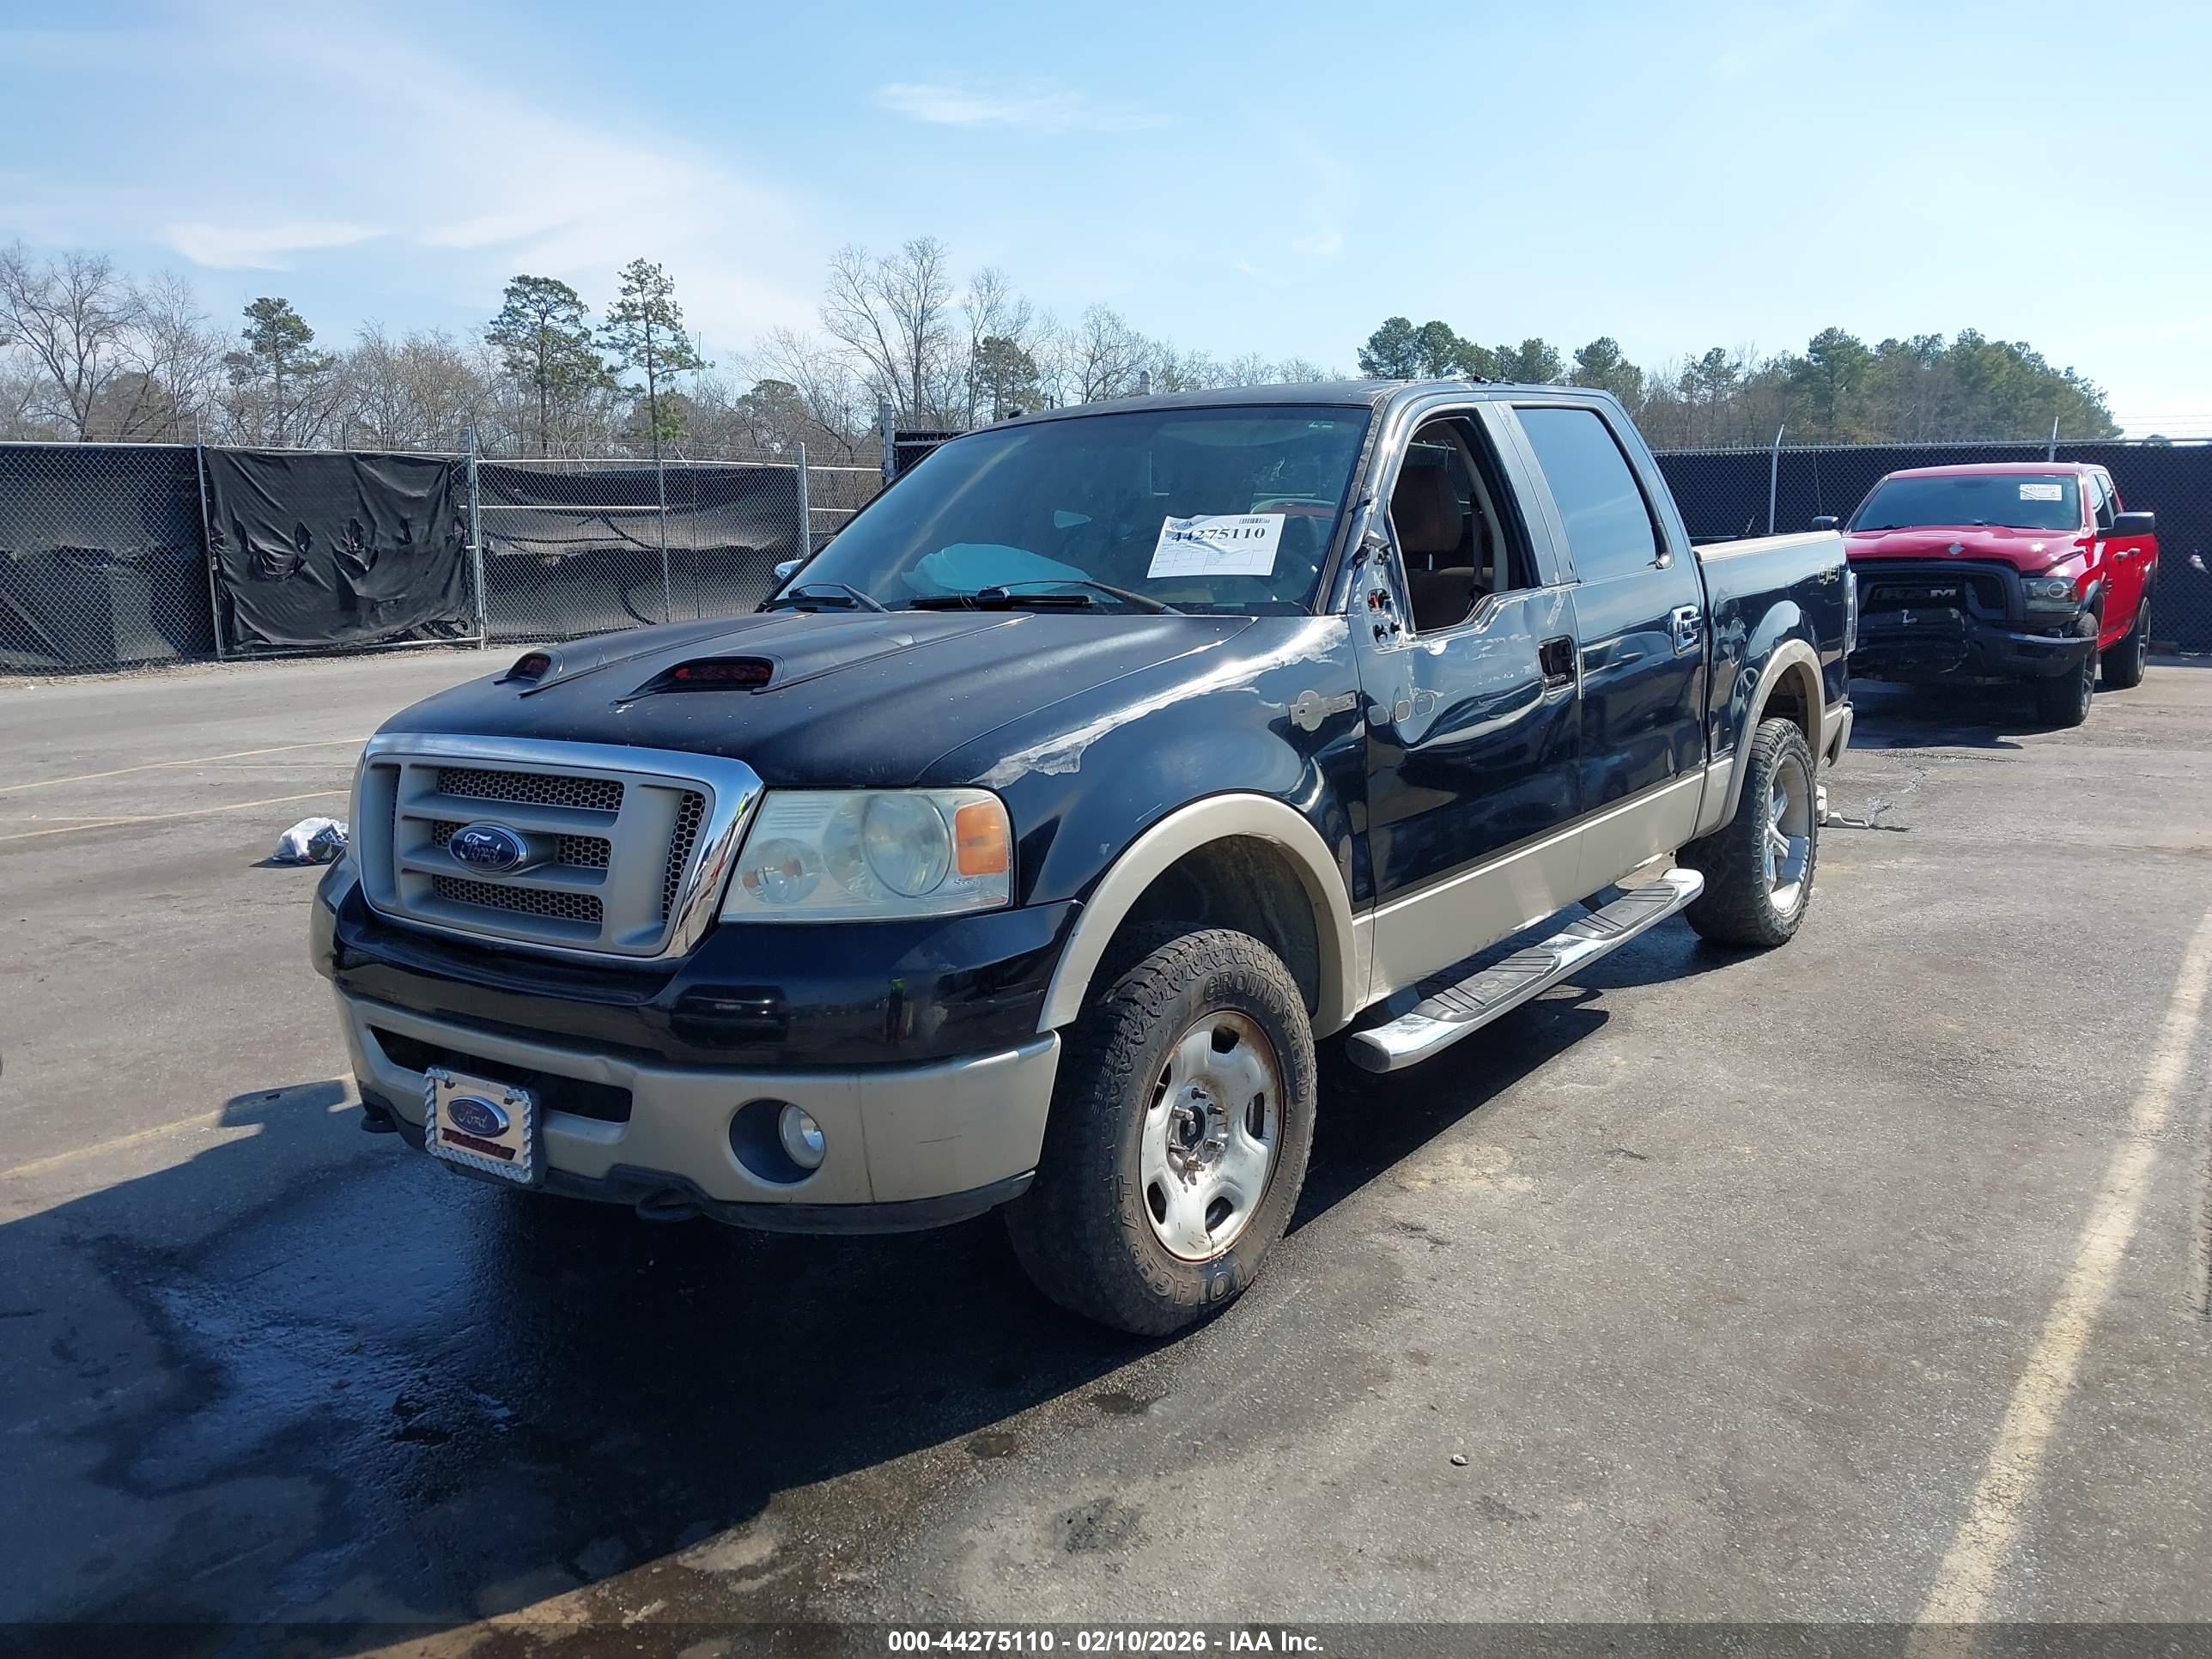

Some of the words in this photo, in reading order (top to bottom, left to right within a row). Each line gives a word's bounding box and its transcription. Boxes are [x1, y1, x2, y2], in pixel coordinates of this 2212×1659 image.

[1172, 527, 1266, 543] 44275110
[459, 831, 502, 864] Ford
[458, 1103, 489, 1129] Ford
